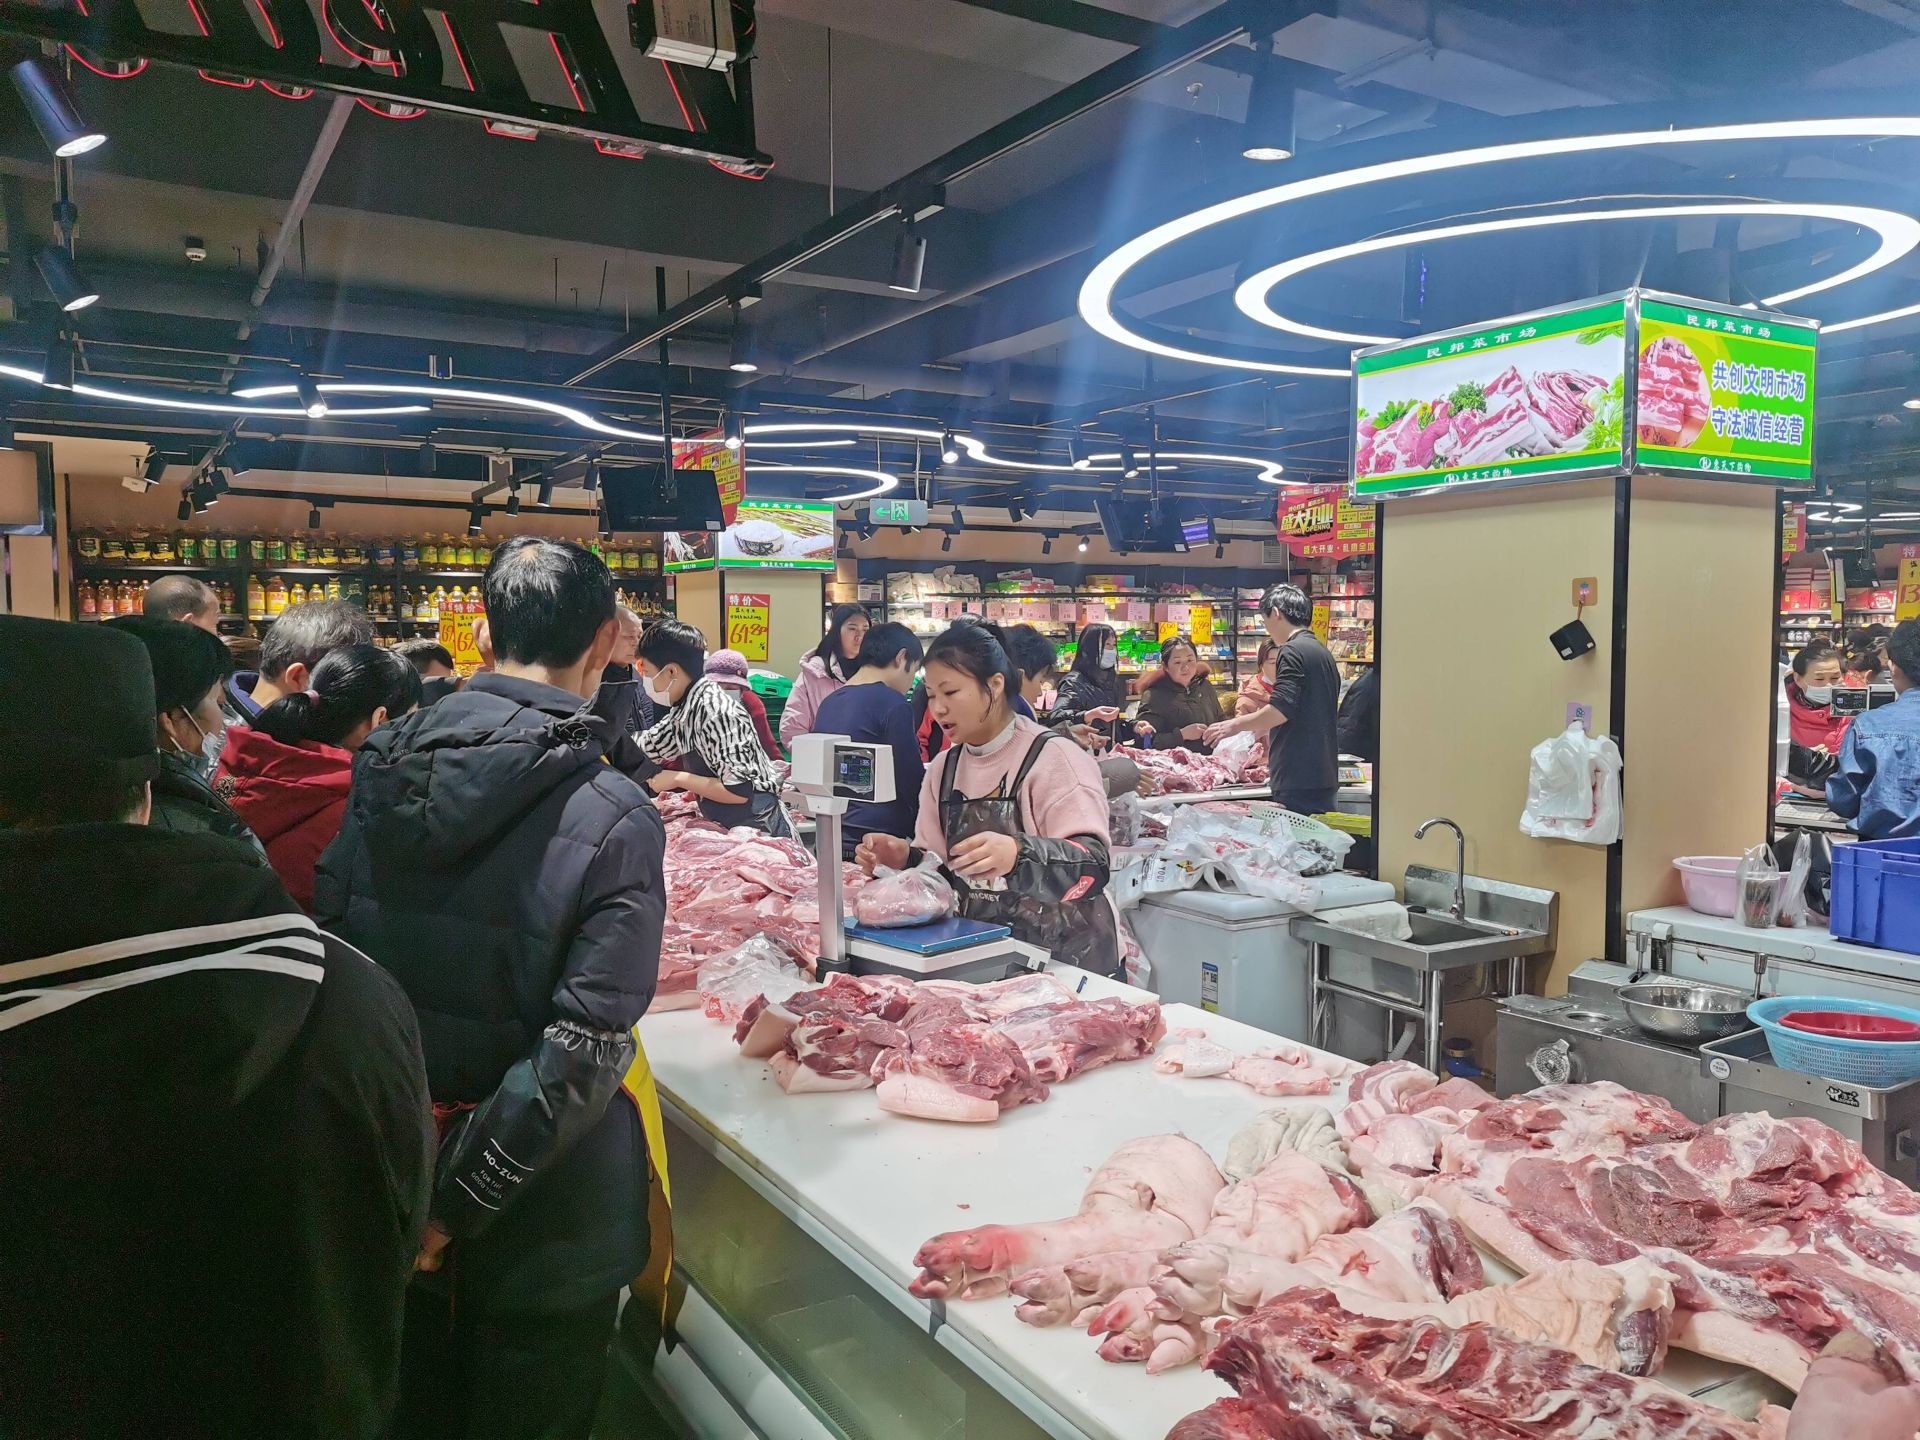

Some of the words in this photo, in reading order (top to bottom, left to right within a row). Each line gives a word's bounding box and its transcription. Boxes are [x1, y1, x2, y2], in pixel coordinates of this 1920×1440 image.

[1686, 314, 1771, 339] 民邦菜市场
[1427, 327, 1536, 358] 民邦菜市场
[1712, 361, 1805, 401] 共创文明市场
[1711, 407, 1804, 444] 守法诚信经营
[729, 595, 752, 607] 特价
[968, 892, 1000, 902] MICKEY
